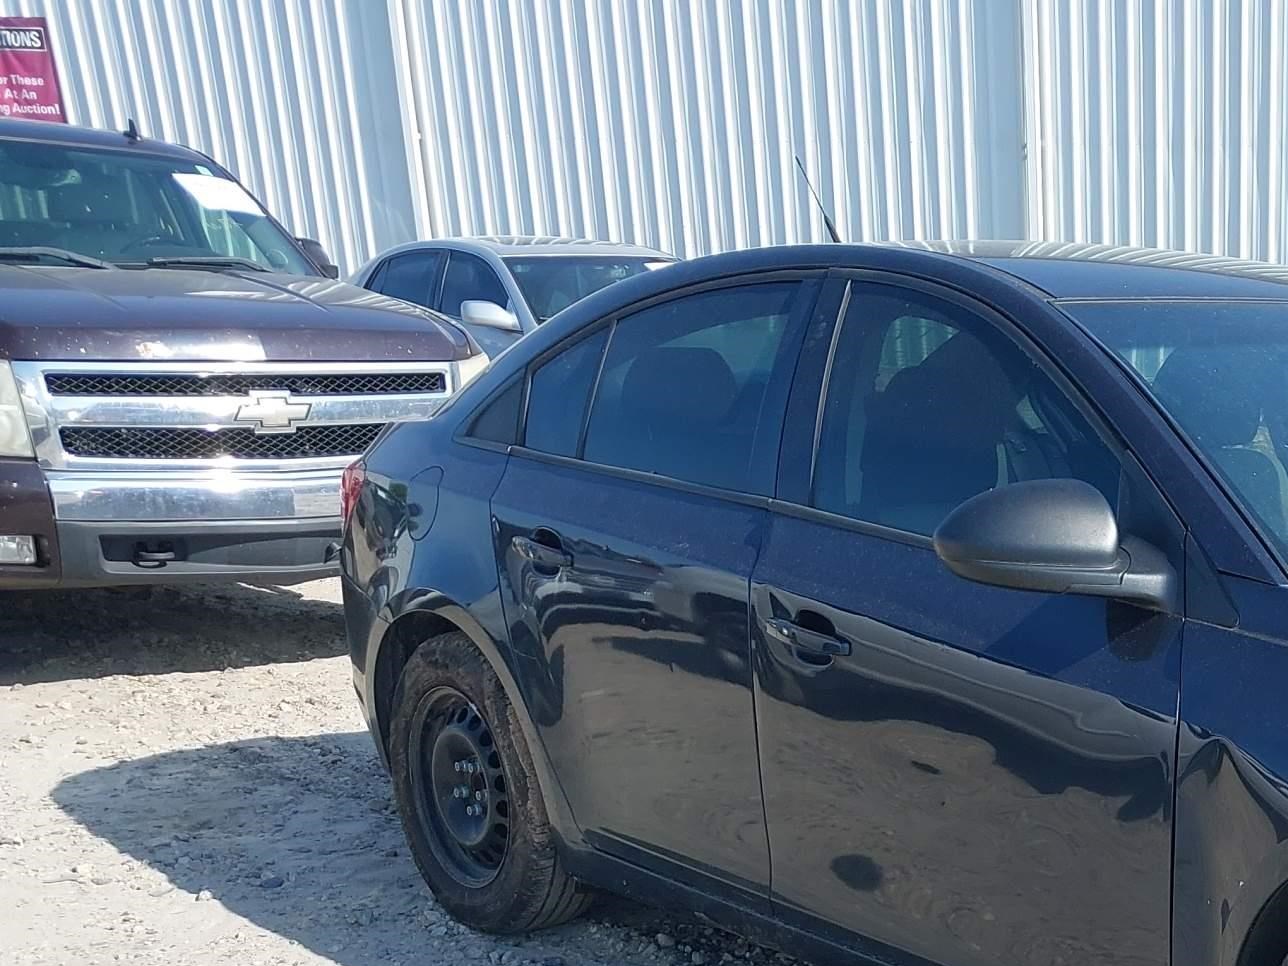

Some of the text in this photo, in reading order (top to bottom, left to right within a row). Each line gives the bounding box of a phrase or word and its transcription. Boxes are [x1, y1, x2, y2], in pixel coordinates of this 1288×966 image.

[0, 30, 41, 47] TIONS
[10, 75, 45, 86] These
[4, 88, 37, 99] At An
[13, 104, 61, 115] Auction!
